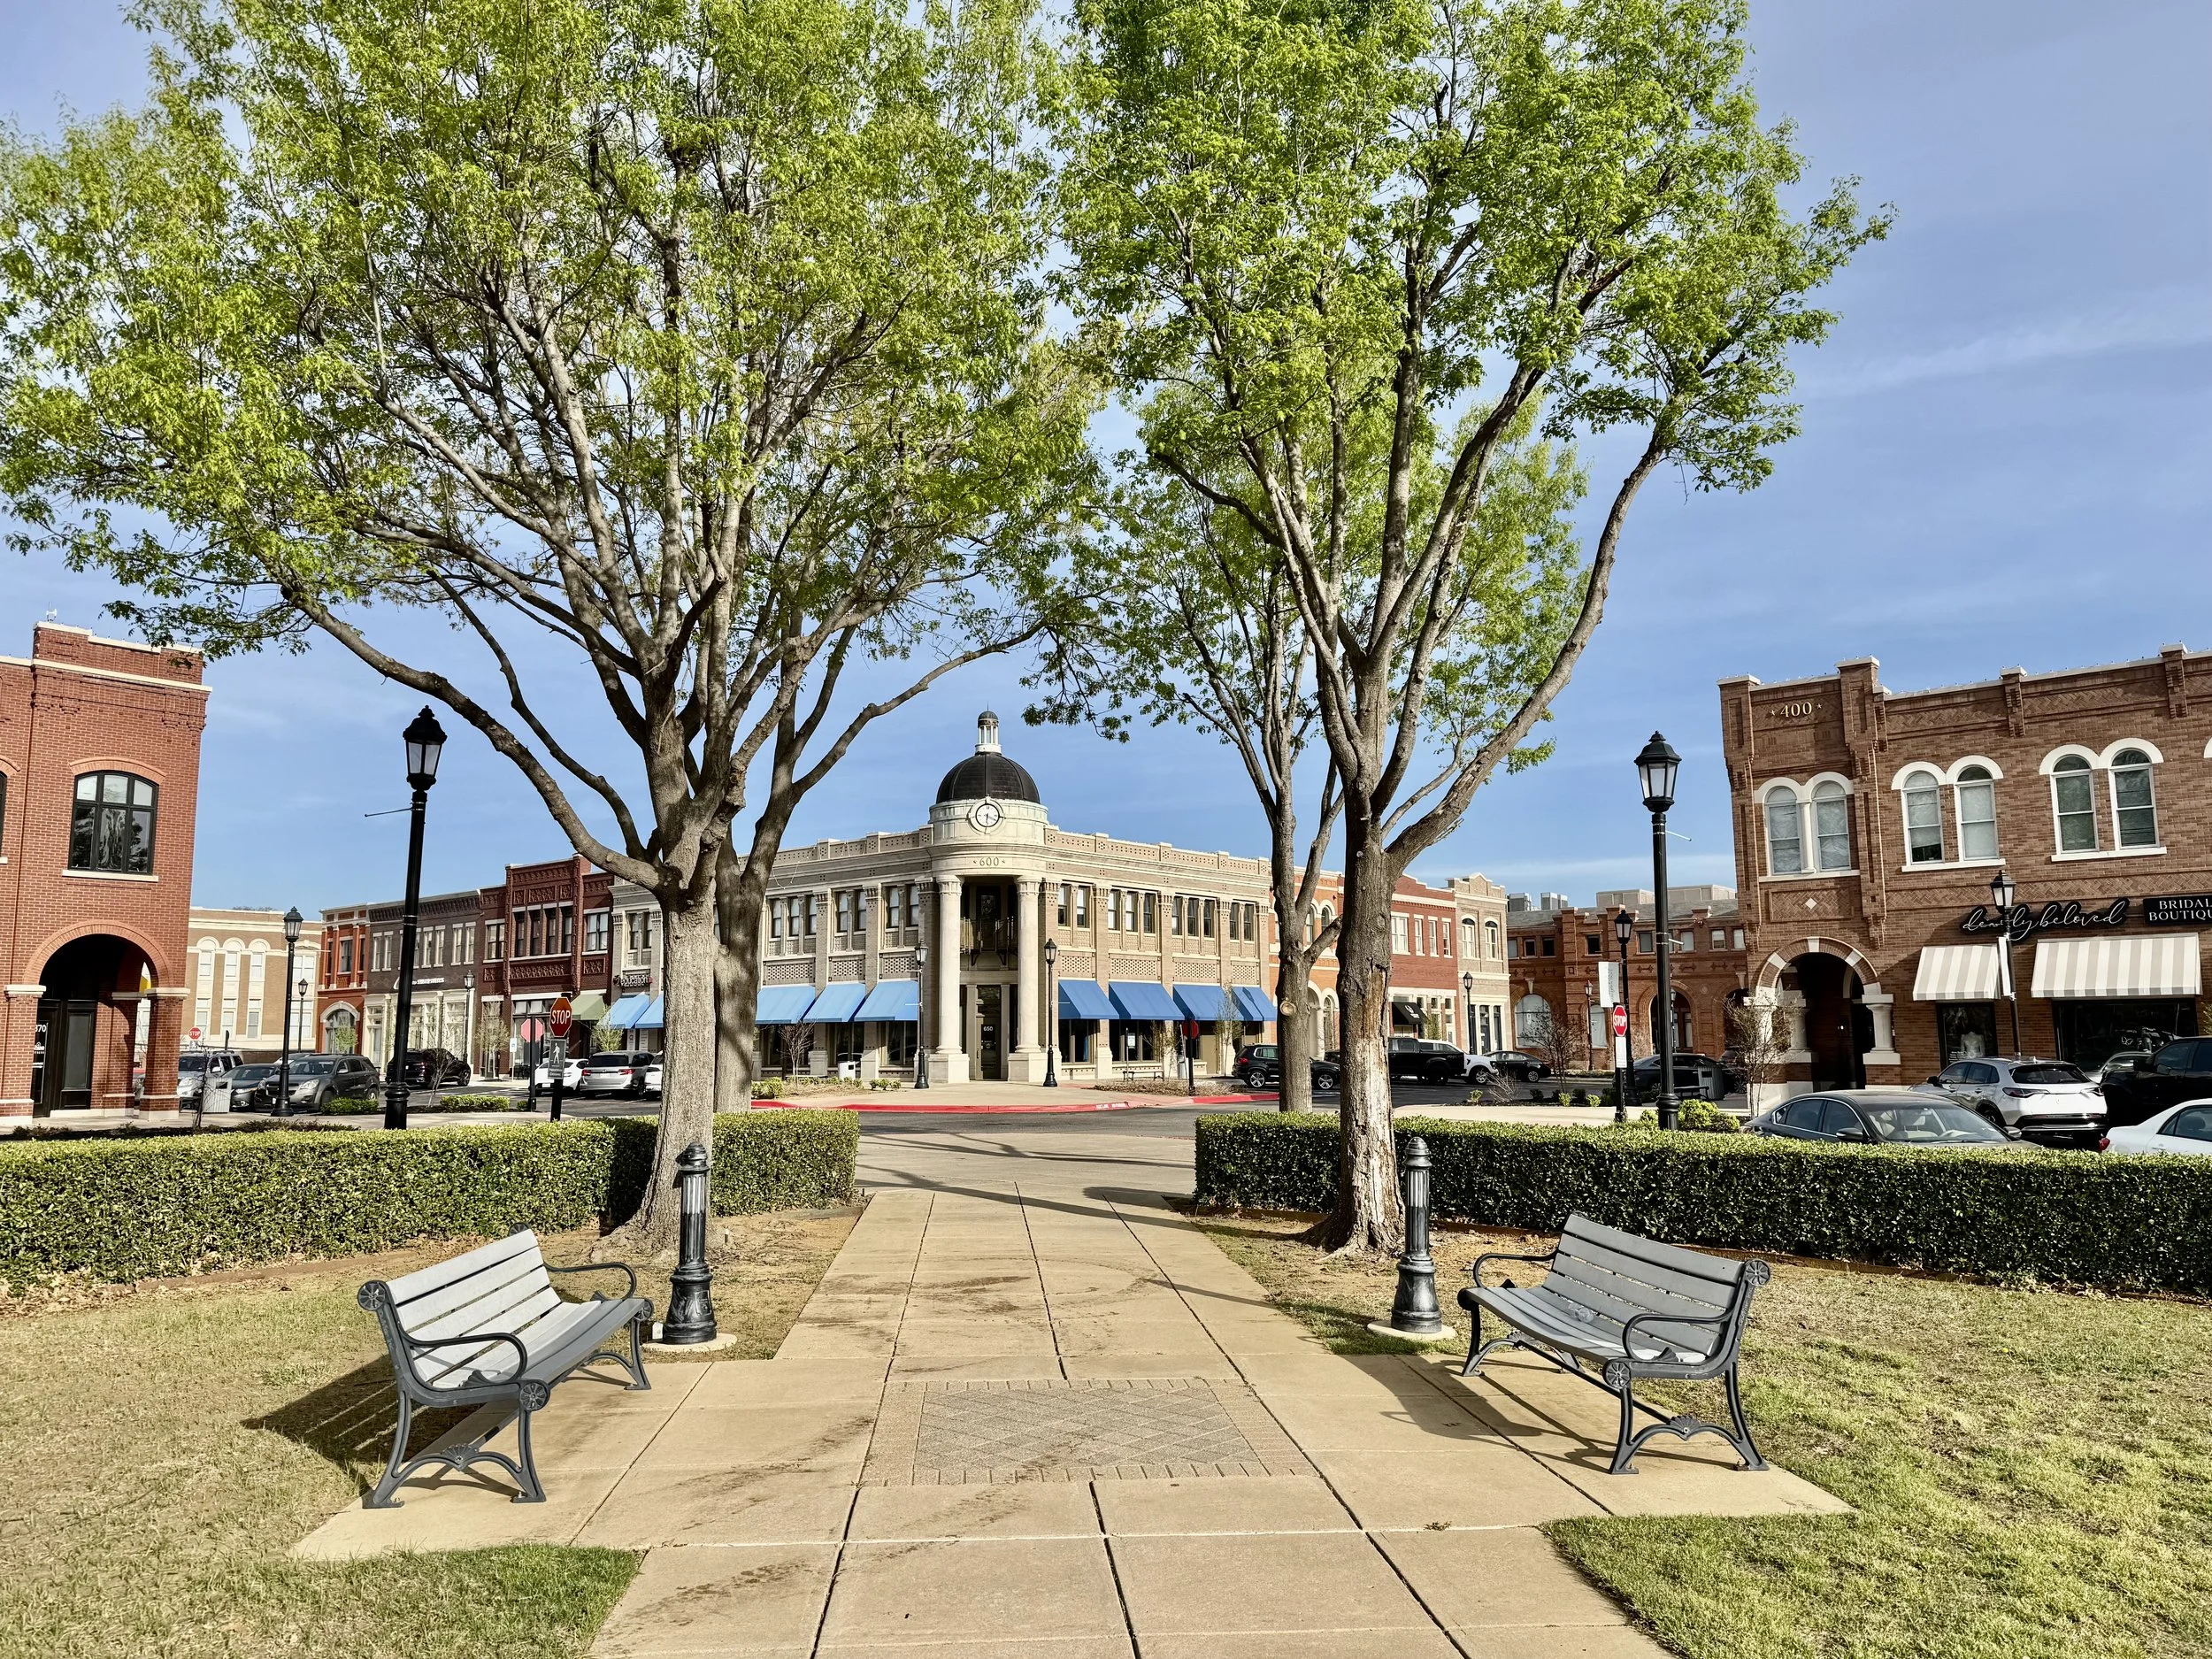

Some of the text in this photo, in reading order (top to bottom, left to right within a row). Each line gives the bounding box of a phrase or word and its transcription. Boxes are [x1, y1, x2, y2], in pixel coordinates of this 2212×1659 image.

[1779, 702, 1813, 718] 400
[979, 856, 1000, 866] 600
[2159, 898, 2212, 910] BRIDAL
[2039, 901, 2126, 926] beloved
[550, 1010, 571, 1025] STOP
[1613, 1015, 1627, 1026] STOP
